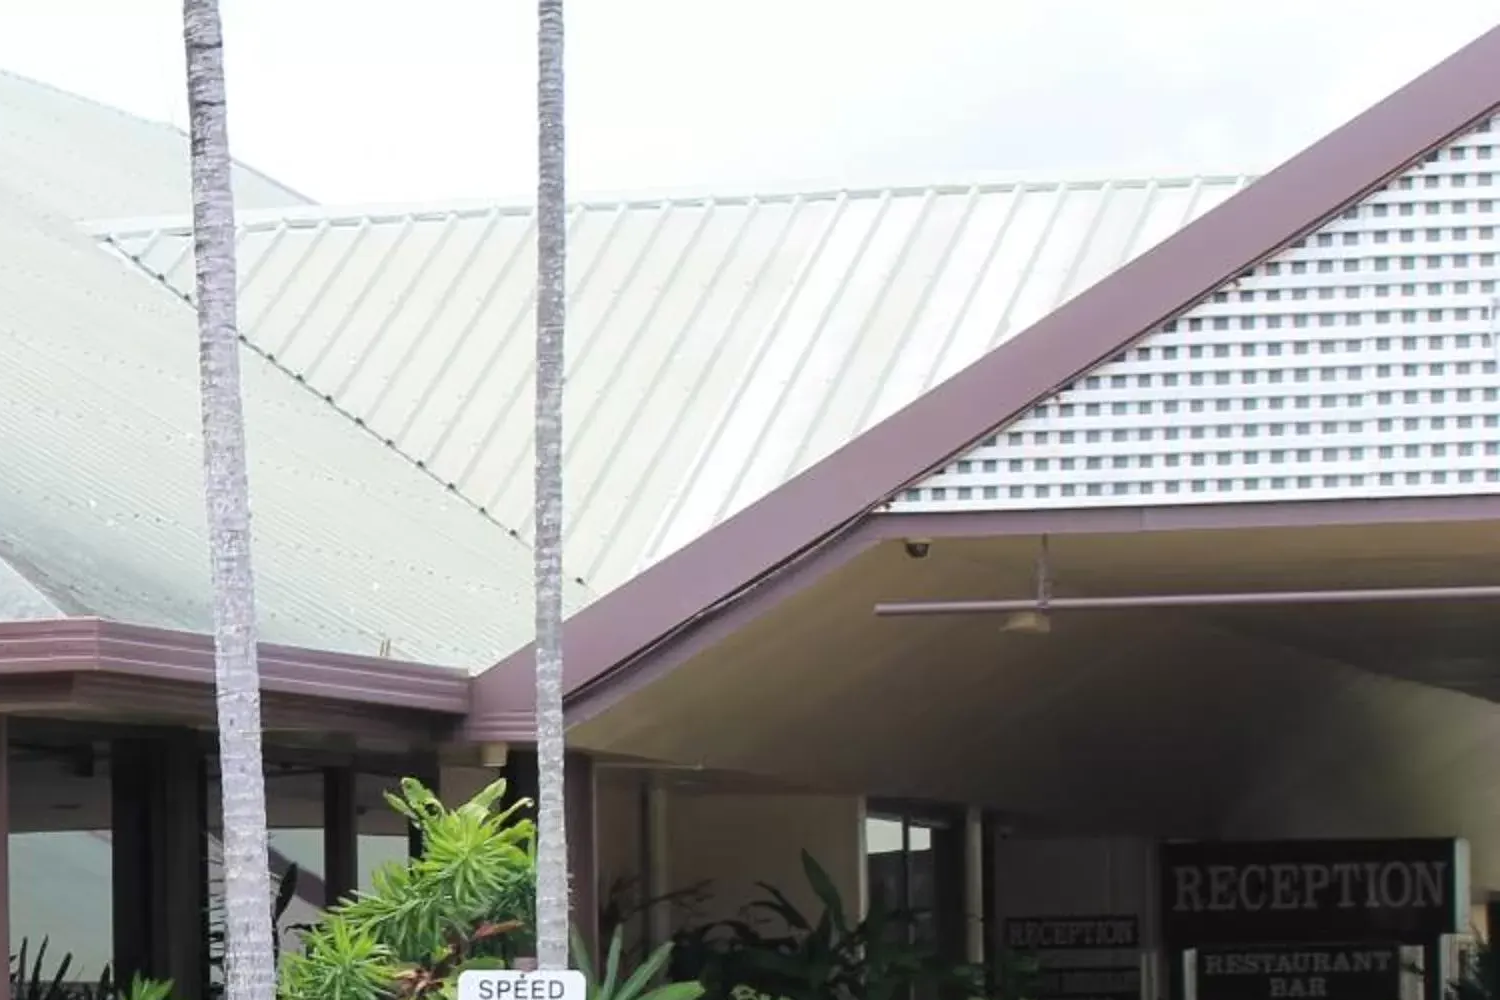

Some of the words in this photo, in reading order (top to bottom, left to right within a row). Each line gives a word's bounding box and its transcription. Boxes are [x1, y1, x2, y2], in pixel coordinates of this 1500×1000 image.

[1171, 860, 1448, 912] RECEPTION
[1203, 951, 1393, 975] RESTAURANT
[478, 979, 565, 1000] SPEED
[1268, 976, 1328, 998] BAR
